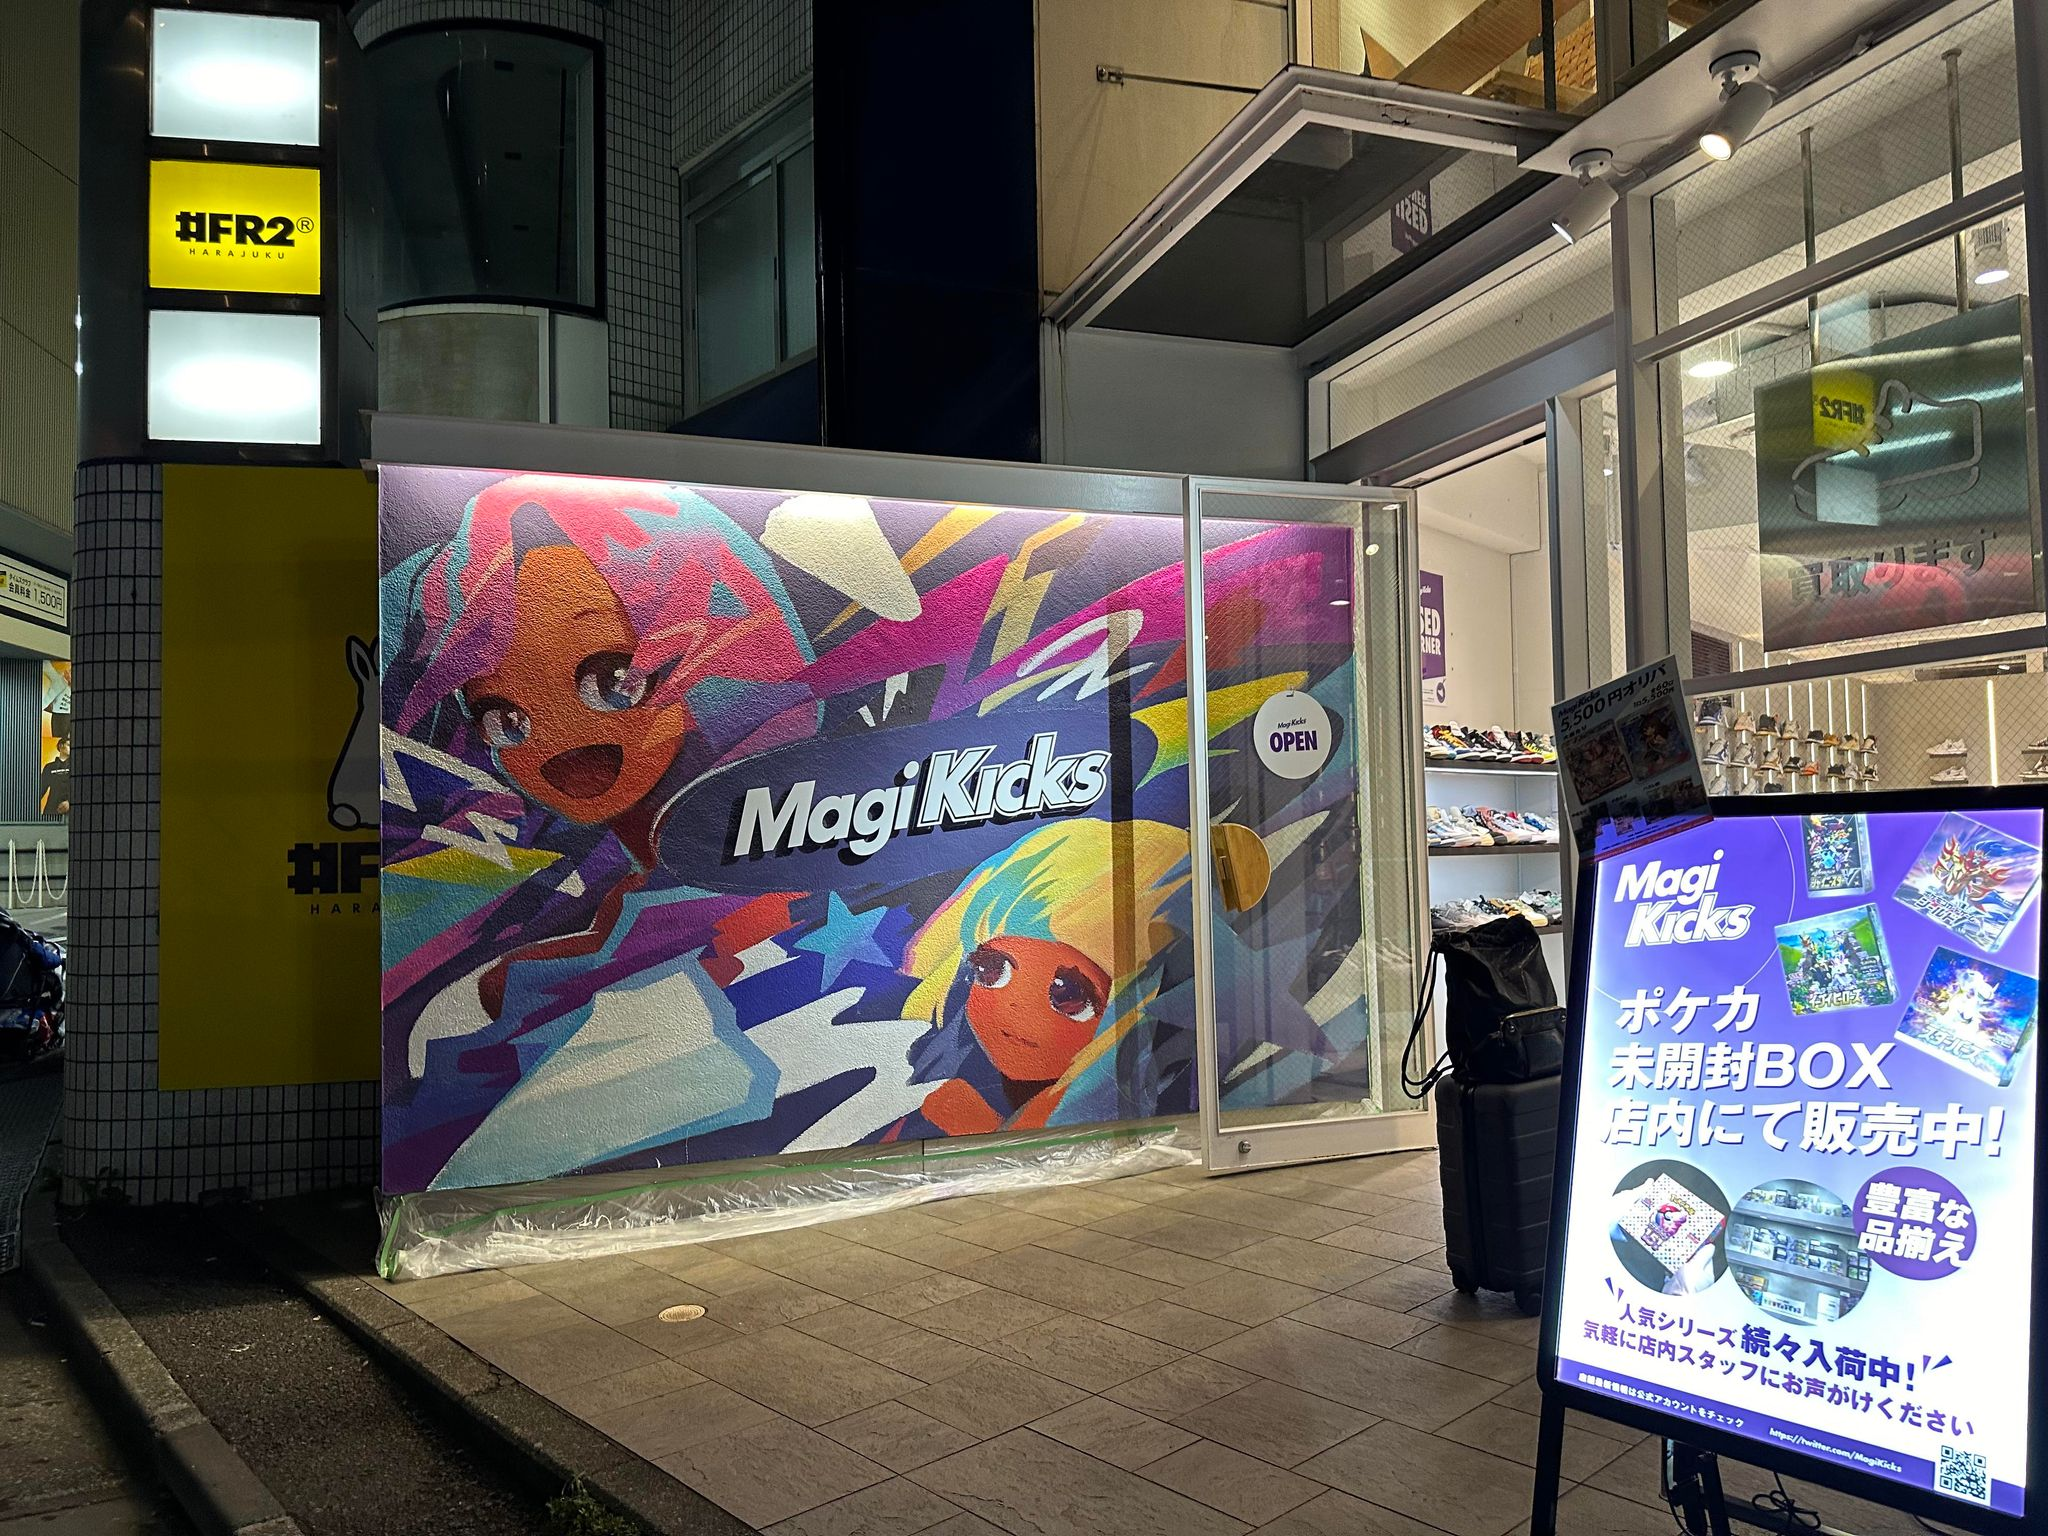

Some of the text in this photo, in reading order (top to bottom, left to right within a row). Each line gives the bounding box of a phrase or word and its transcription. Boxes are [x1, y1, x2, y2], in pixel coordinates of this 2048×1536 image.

[189, 248, 285, 260] HARAJUKU
[1787, 528, 1997, 602] 買取ります
[1269, 730, 1318, 752] OPEN
[1614, 849, 1724, 905] Magi
[1624, 891, 1756, 948] Kicks
[1615, 985, 1760, 1035] ポケカ
[1607, 1041, 1896, 1091] 未開封BOX
[1601, 1097, 2006, 1160] 店内にて販売中!
[1862, 1181, 1972, 1230] 豊富な
[1857, 1218, 1968, 1269] 品揃え
[1583, 1319, 1975, 1436] 気軽に店内スタッフにお声がけください
[1769, 1427, 1902, 1473] https://twitter.com/MagiKicks
